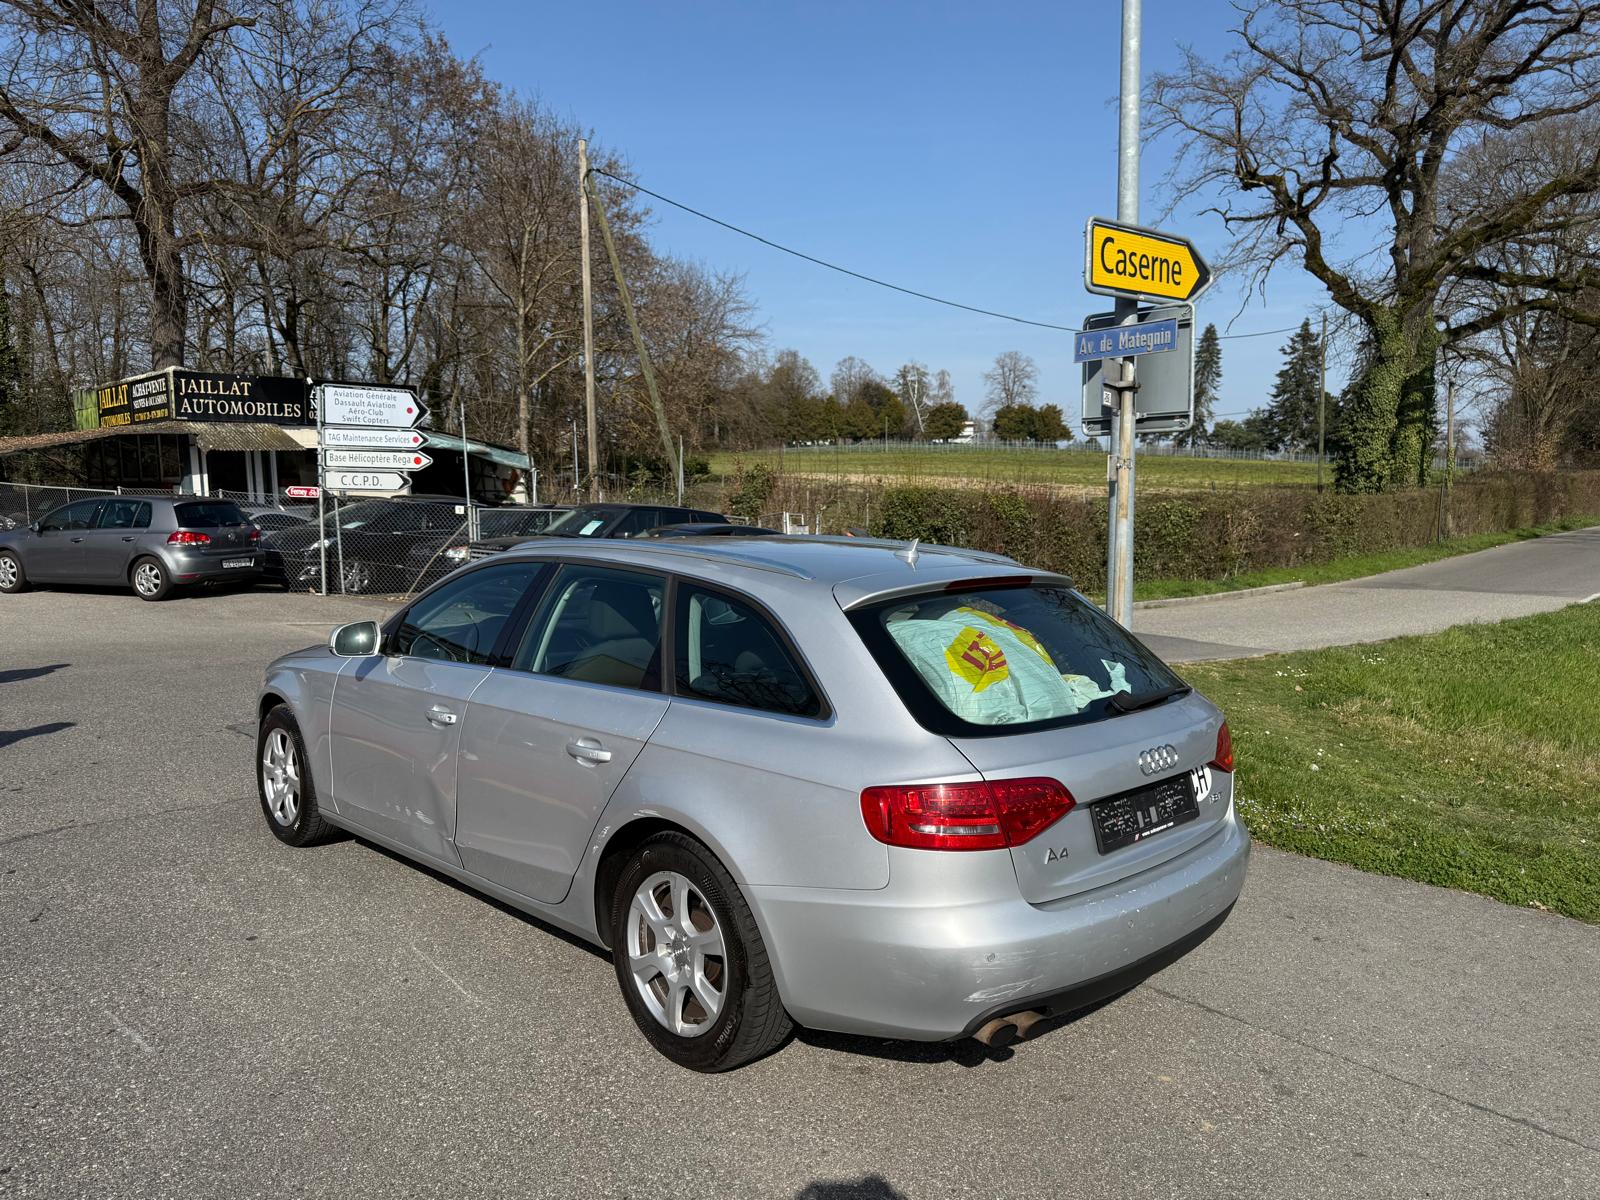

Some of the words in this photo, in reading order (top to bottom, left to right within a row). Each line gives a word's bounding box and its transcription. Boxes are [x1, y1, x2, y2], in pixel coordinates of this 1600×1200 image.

[1101, 236, 1182, 286] Caserne
[1079, 335, 1096, 355] Av.
[1100, 333, 1113, 352] de
[1119, 328, 1171, 352] Mategnin
[132, 377, 167, 398] ACHAT-VENTE
[180, 378, 252, 396] JAILLAT
[333, 390, 364, 399] Aviation
[365, 391, 397, 401] Générale
[98, 384, 129, 414] JAILLAT
[334, 398, 365, 408] Dassault
[366, 400, 396, 409] Aviation
[181, 398, 302, 418] AUTOMOBILES
[348, 407, 384, 416] Aéro-Club
[101, 411, 131, 428] AUTOMOBILES
[342, 415, 361, 423] Swift
[362, 416, 390, 425] Copters
[328, 433, 341, 441] TAG
[342, 433, 382, 443] Maintenance
[384, 434, 410, 444] Services
[329, 453, 347, 462] Base
[348, 453, 391, 465] Hélicoptère
[392, 454, 411, 466] Rega
[340, 475, 383, 487] C.C.P.D.
[1045, 847, 1069, 865] A4
